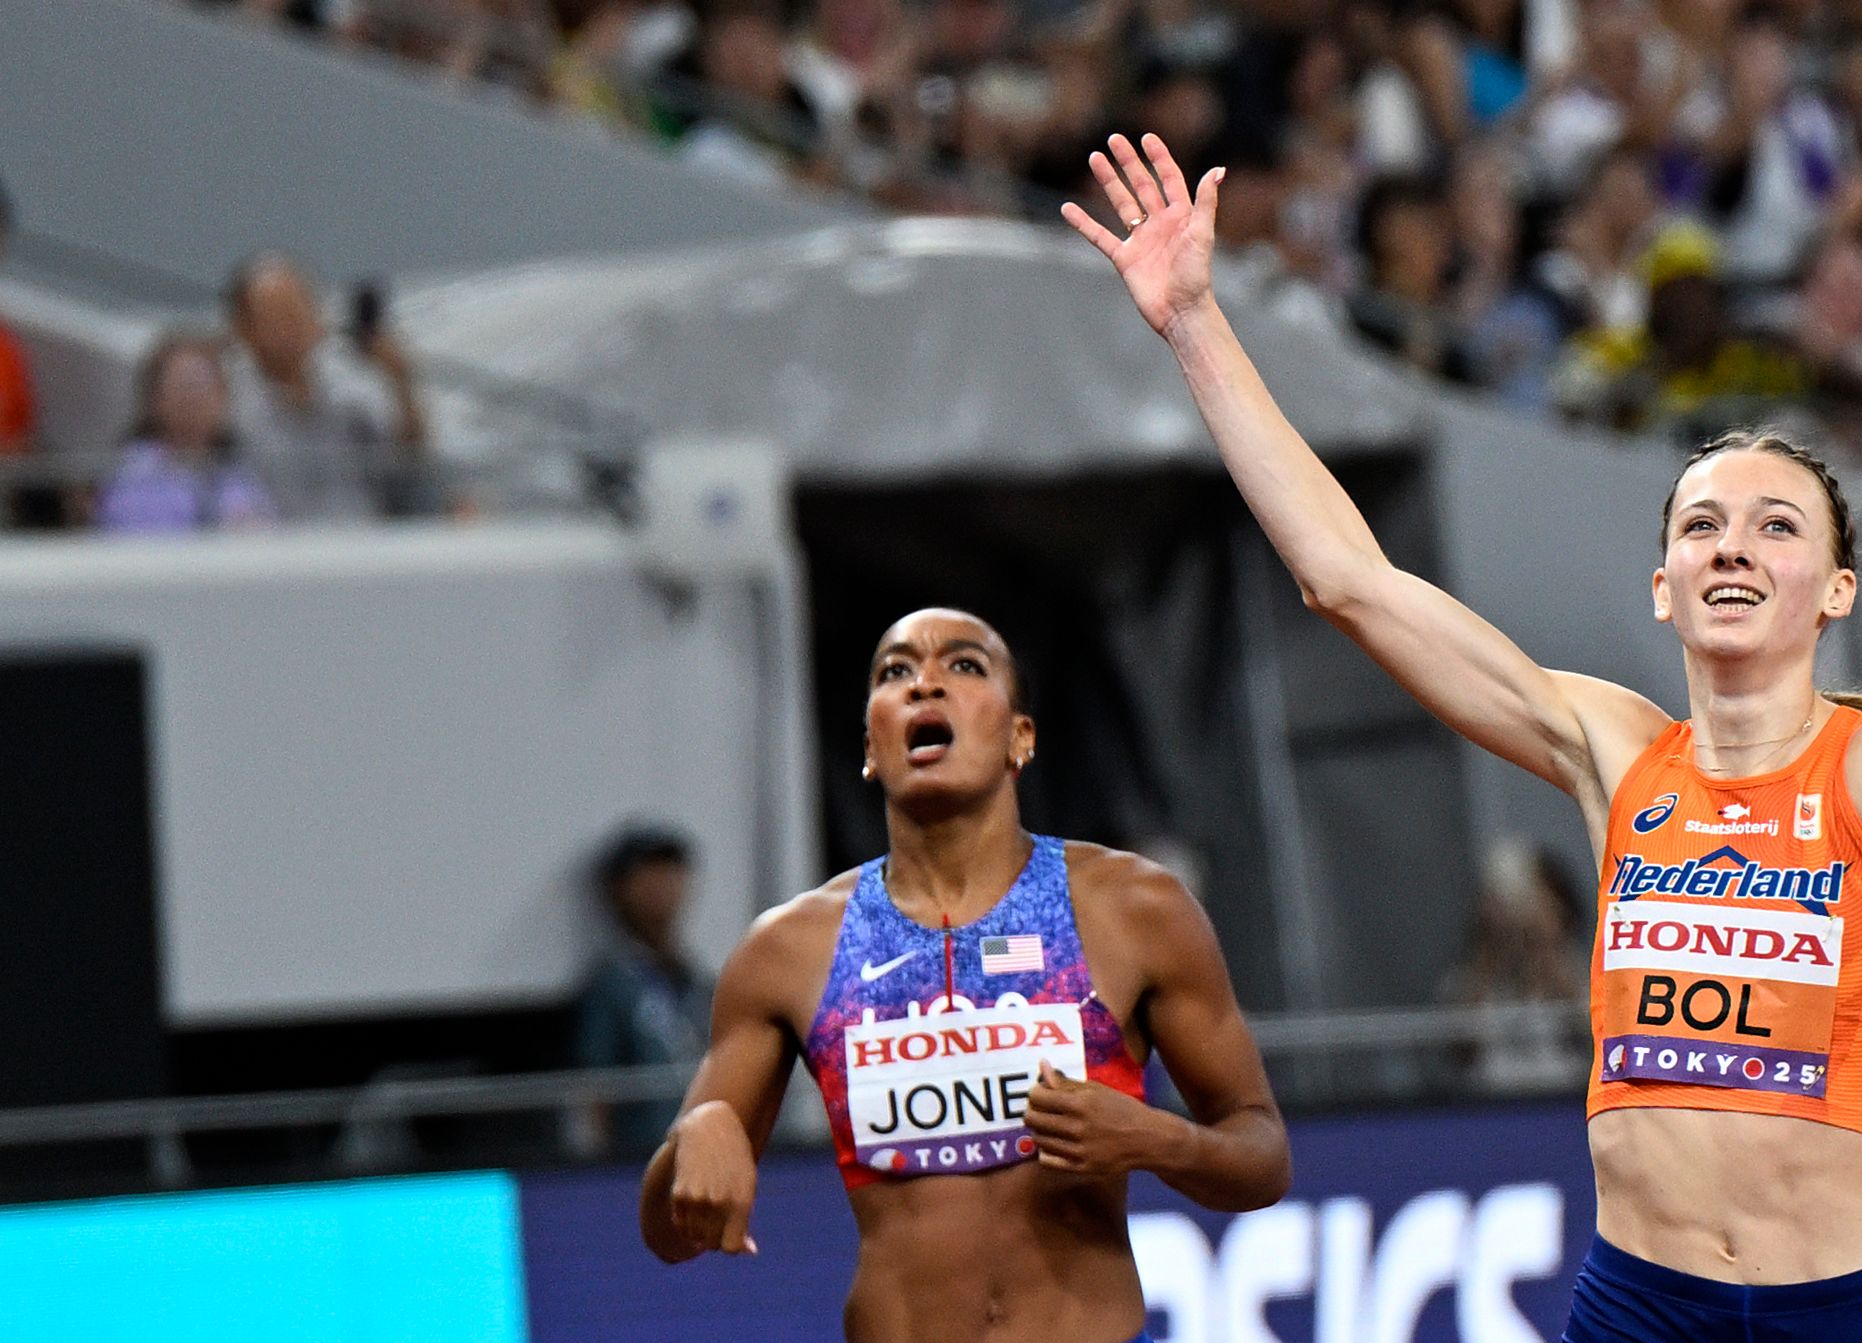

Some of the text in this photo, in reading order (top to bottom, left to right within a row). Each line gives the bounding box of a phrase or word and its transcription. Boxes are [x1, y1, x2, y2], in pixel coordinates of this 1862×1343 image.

[1684, 818, 1780, 837] Staatsloterij
[1607, 920, 1835, 967] HONDA
[1636, 974, 1772, 1038] BOL
[852, 1019, 1075, 1069] HONDA
[868, 1071, 1042, 1135] JONE
